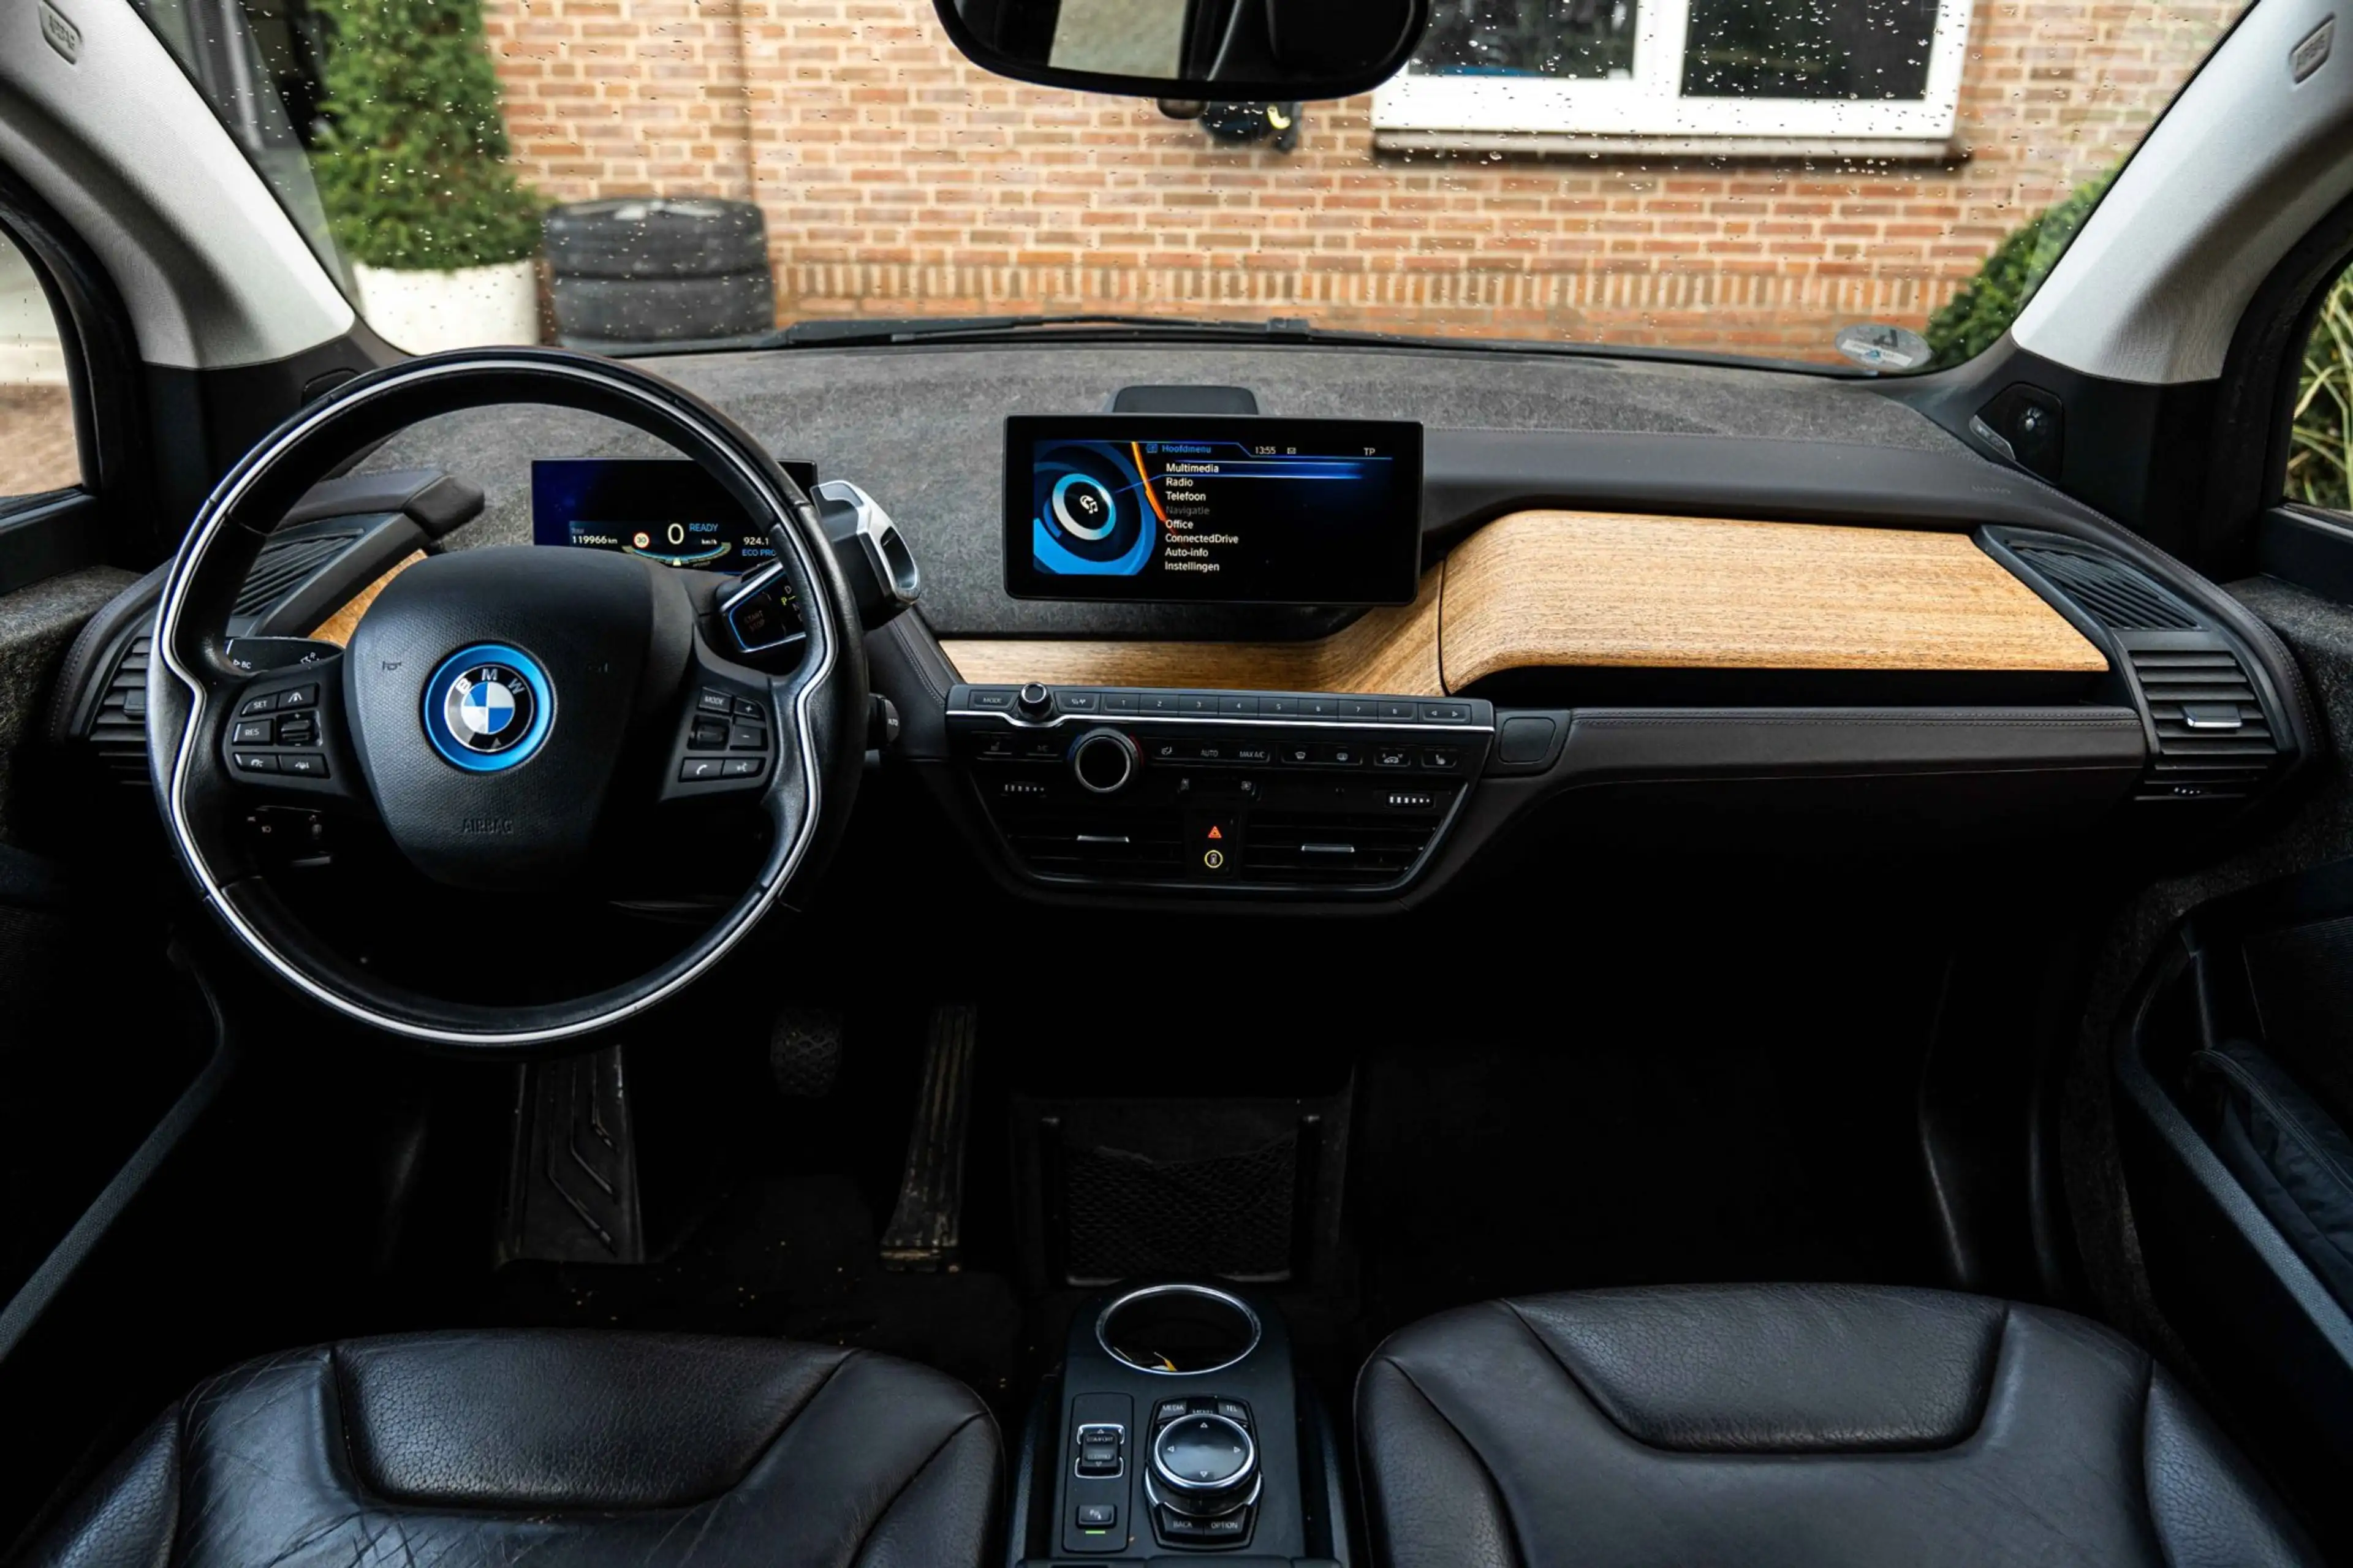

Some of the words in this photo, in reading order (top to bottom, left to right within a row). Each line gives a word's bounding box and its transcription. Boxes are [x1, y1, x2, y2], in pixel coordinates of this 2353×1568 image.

[1162, 445, 1211, 454] Hoofdmenu
[1255, 446, 1276, 455] 13:55
[1363, 447, 1376, 456] TP
[1165, 463, 1219, 473] Multimedia
[1165, 477, 1194, 487] Radio
[1165, 491, 1206, 501] Telefoon
[1165, 506, 1210, 517] Navigatie
[689, 523, 718, 532] READY
[1165, 520, 1194, 529] Office
[667, 523, 684, 545] 0
[1165, 533, 1239, 544] ConnectedDrive
[572, 535, 607, 545] 119966
[743, 537, 770, 546] 924.1
[1165, 547, 1208, 557] Auto-info
[1165, 561, 1219, 573] Instellingen
[455, 668, 525, 695] BMW
[253, 700, 267, 710] SET
[245, 728, 260, 737] RES
[1200, 749, 1219, 758] AUTO
[463, 818, 514, 835] AIRBAG
